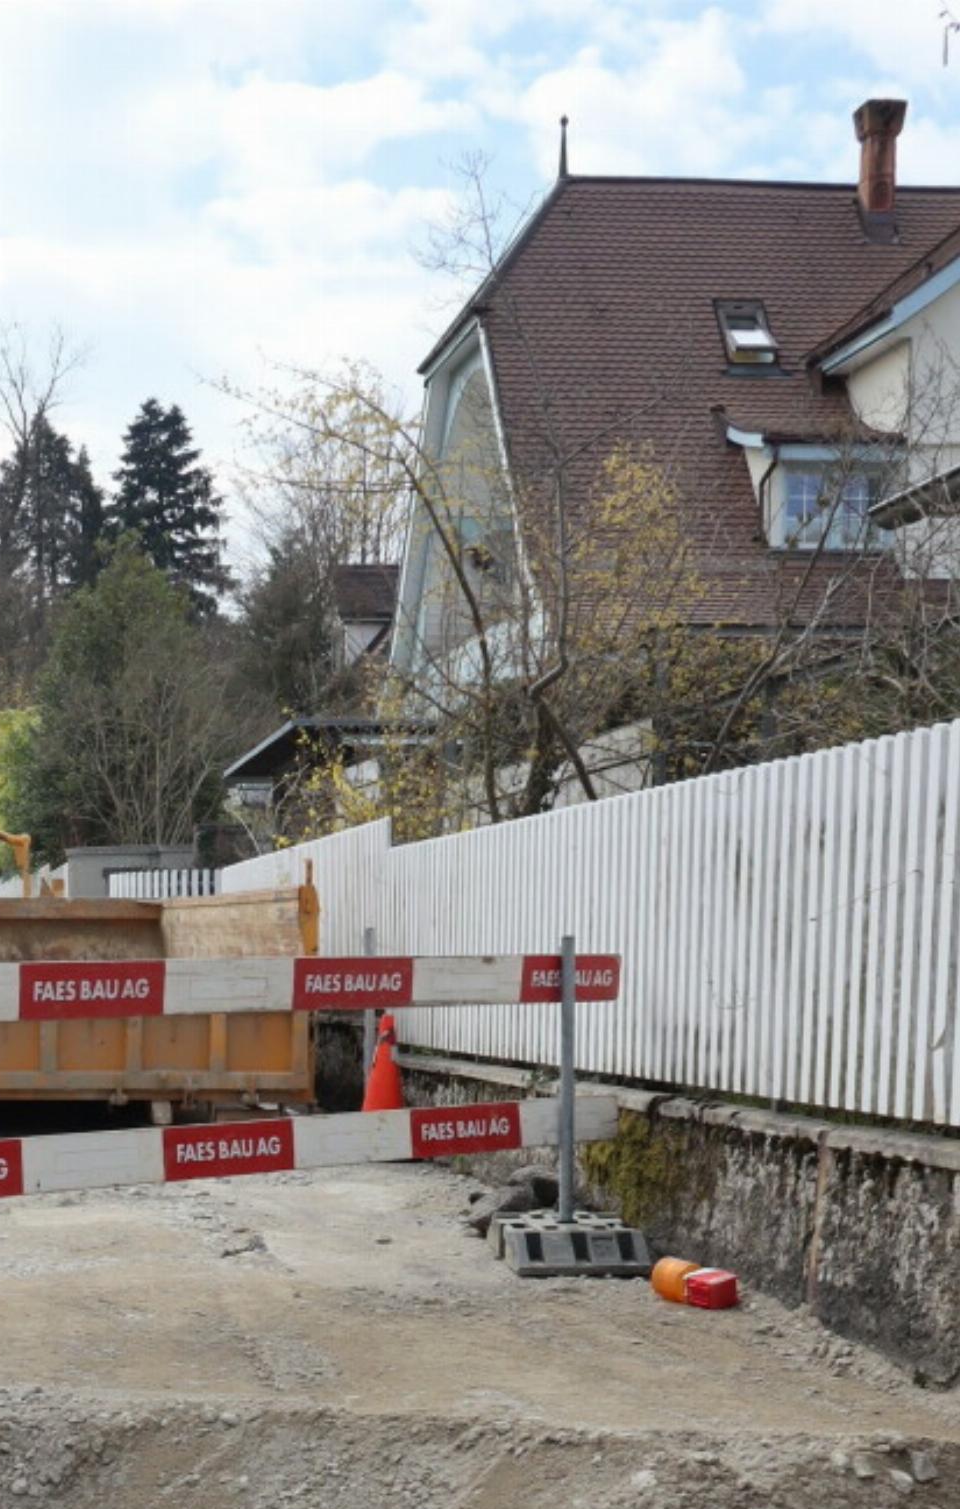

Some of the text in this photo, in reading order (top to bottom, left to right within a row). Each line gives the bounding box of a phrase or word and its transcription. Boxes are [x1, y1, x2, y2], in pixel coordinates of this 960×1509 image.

[32, 977, 151, 1002] FAES BAU AG
[304, 971, 403, 994] FAES BAU AG
[592, 969, 614, 987] AG
[420, 1116, 511, 1142] FAES BAU AG
[176, 1136, 281, 1164] FAES BAU AG
